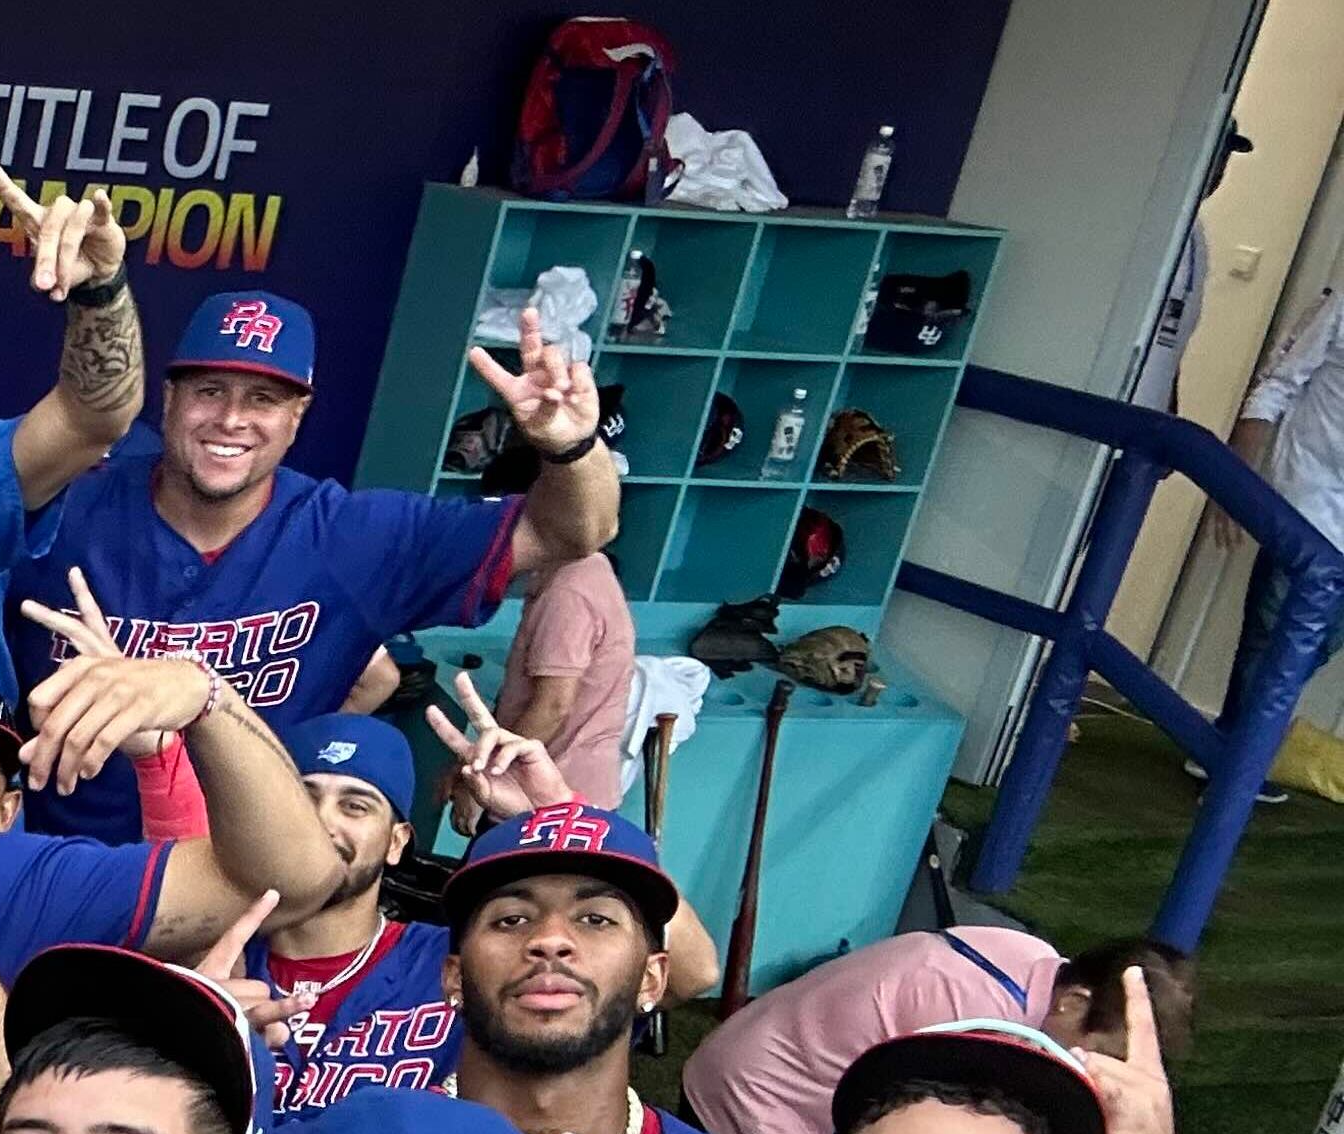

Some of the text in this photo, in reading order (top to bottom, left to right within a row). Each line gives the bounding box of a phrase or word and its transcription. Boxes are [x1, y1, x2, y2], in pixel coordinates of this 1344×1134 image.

[162, 96, 271, 181] OF
[220, 300, 284, 354] PR
[518, 801, 612, 854] PR
